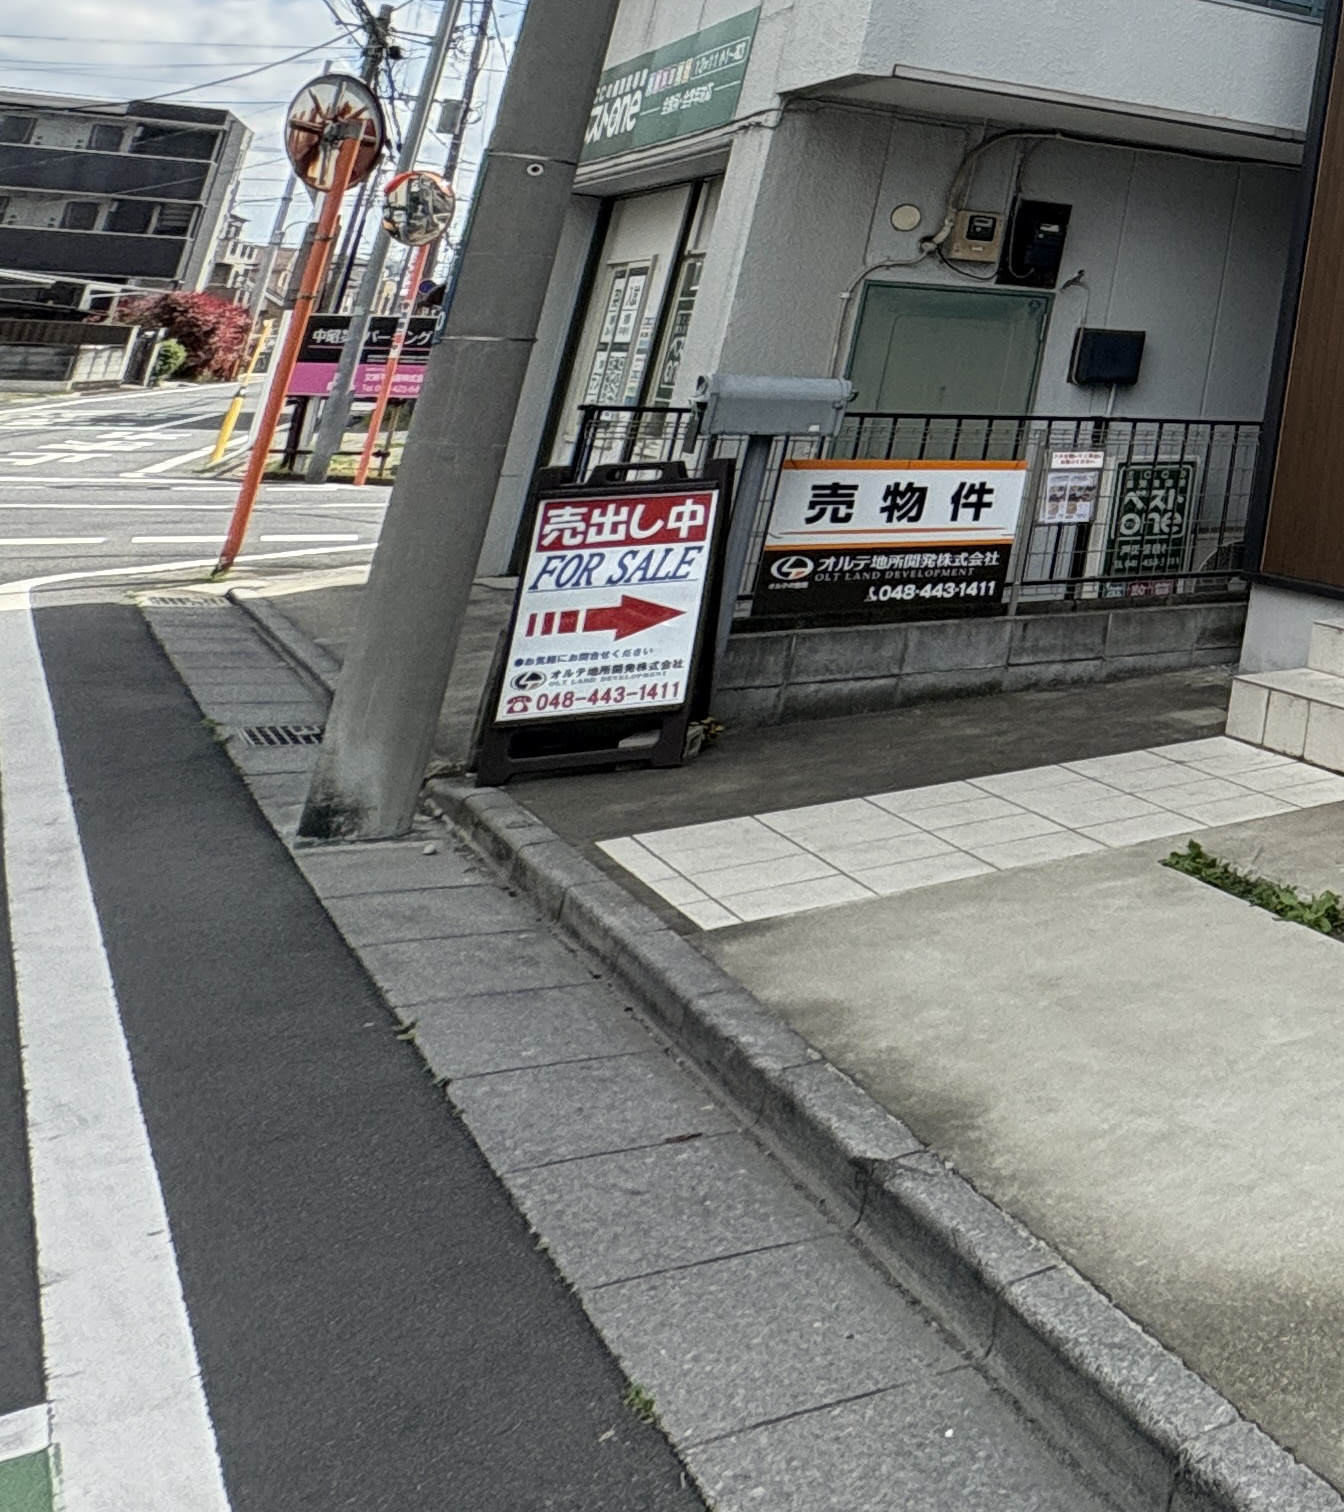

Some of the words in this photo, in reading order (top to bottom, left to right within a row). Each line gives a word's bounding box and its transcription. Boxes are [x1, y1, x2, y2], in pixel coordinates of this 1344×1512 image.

[804, 481, 995, 525] 売物件
[541, 499, 705, 547] 売出し中
[528, 552, 606, 590] FOR
[605, 545, 705, 585] SALE
[814, 571, 843, 582] OLT
[844, 569, 882, 581] LAND
[884, 567, 975, 580] DEVELOPMENT
[817, 551, 1000, 572] オルテ地所開発株式会社
[536, 681, 681, 711] 048-443-1411
